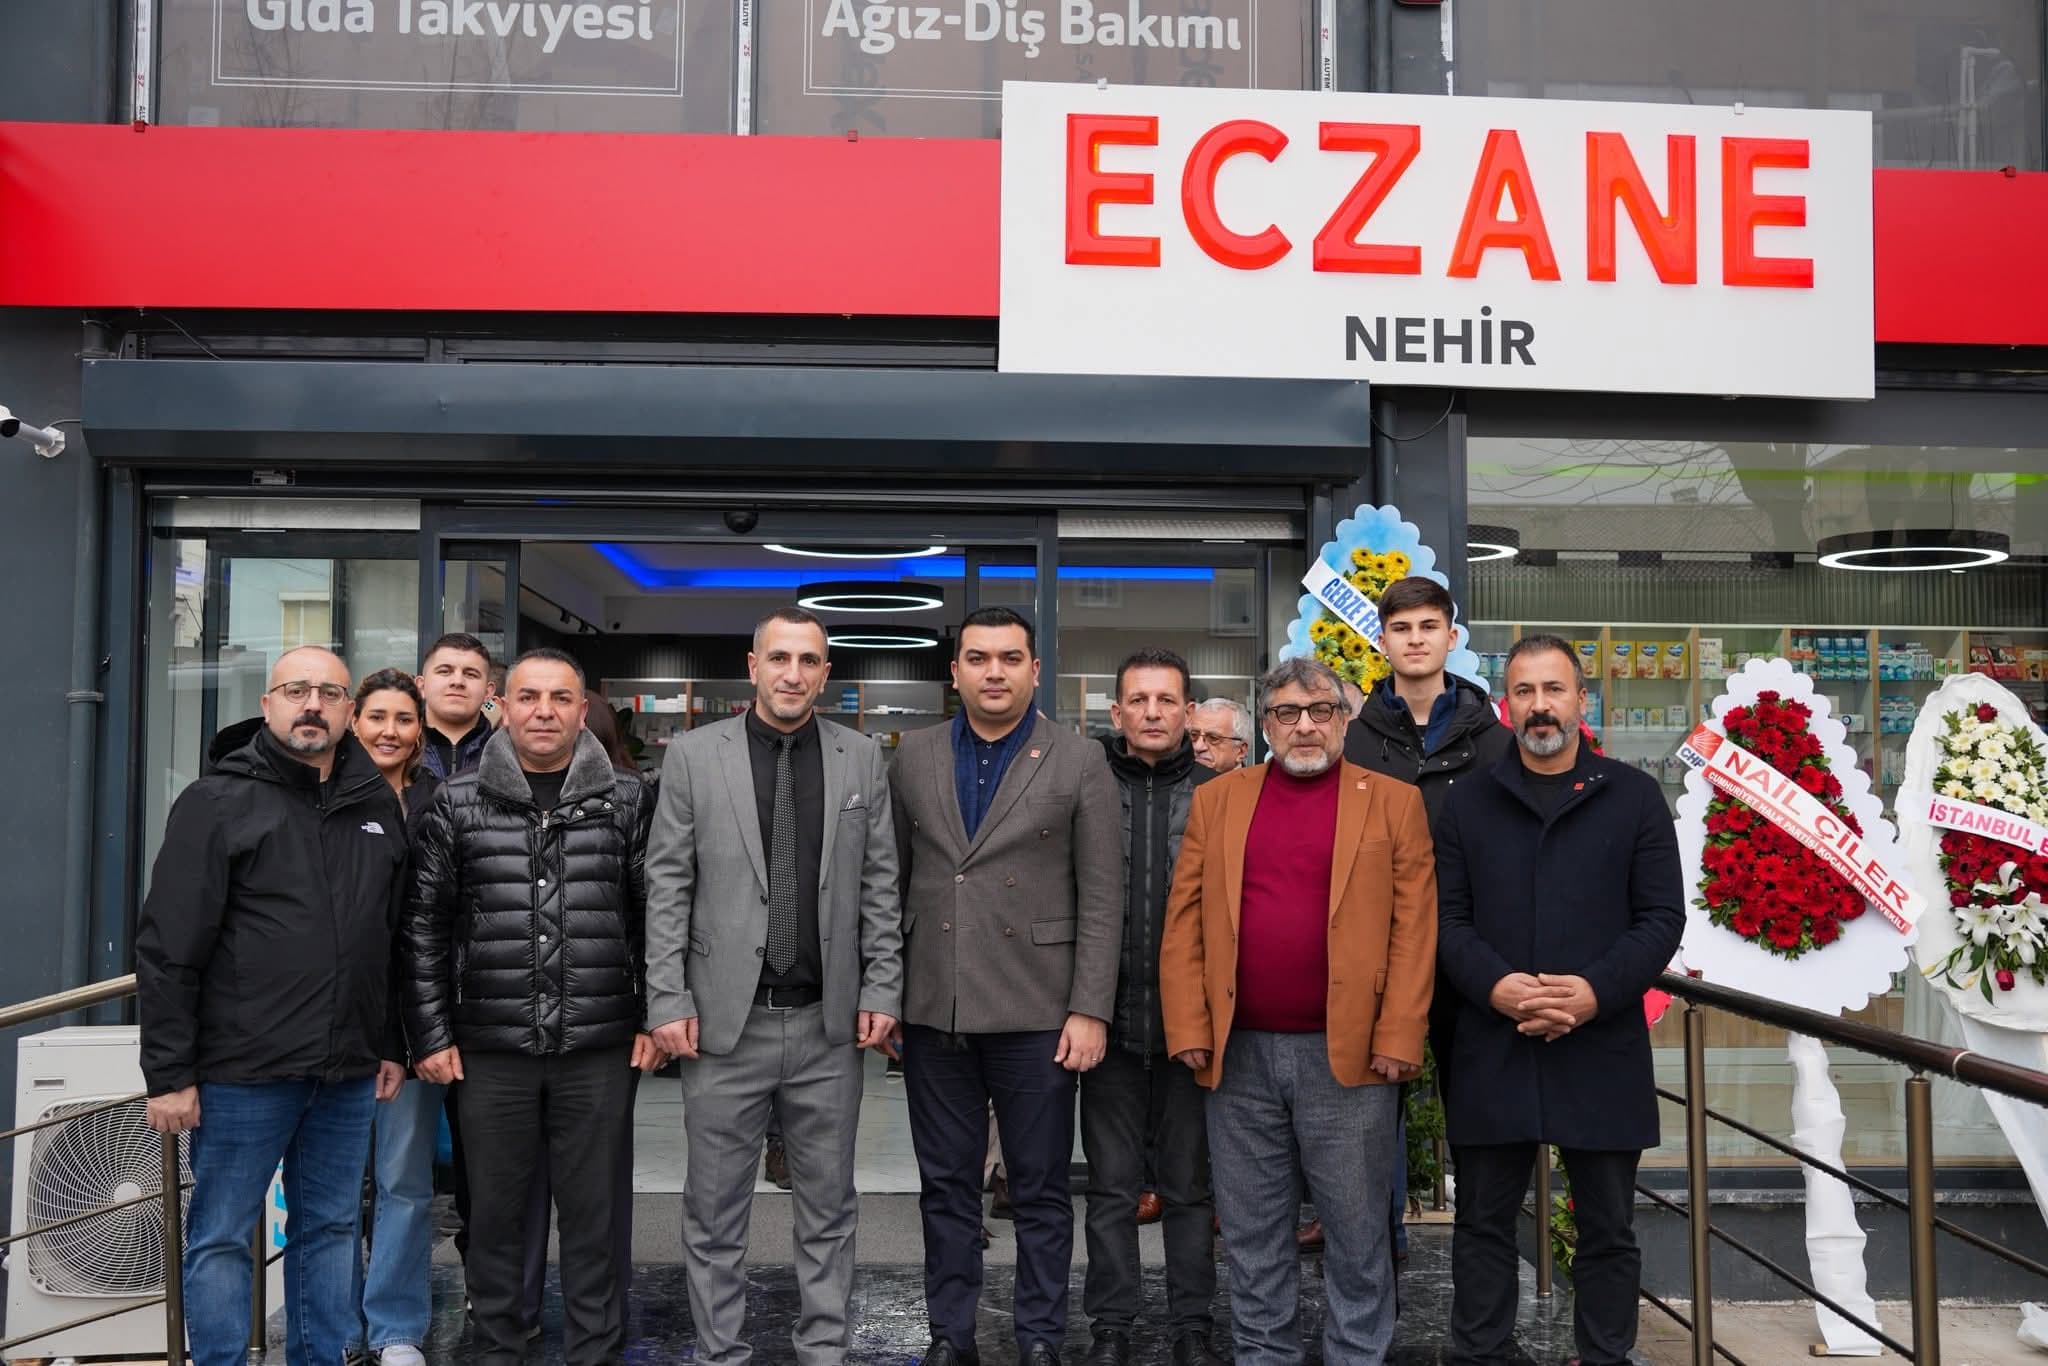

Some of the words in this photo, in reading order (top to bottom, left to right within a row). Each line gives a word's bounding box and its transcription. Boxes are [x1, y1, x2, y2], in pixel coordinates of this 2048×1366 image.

[1061, 0, 1241, 50] Bakımı
[1065, 113, 1814, 288] ECZANE
[1345, 305, 1536, 366] NEHİR
[1321, 578, 1367, 621] GEBZE
[1680, 747, 1706, 768] CHP
[1724, 750, 1800, 816] NAİL
[1814, 815, 1909, 911] ÇİLER
[1928, 799, 2033, 846] İSTANBUL
